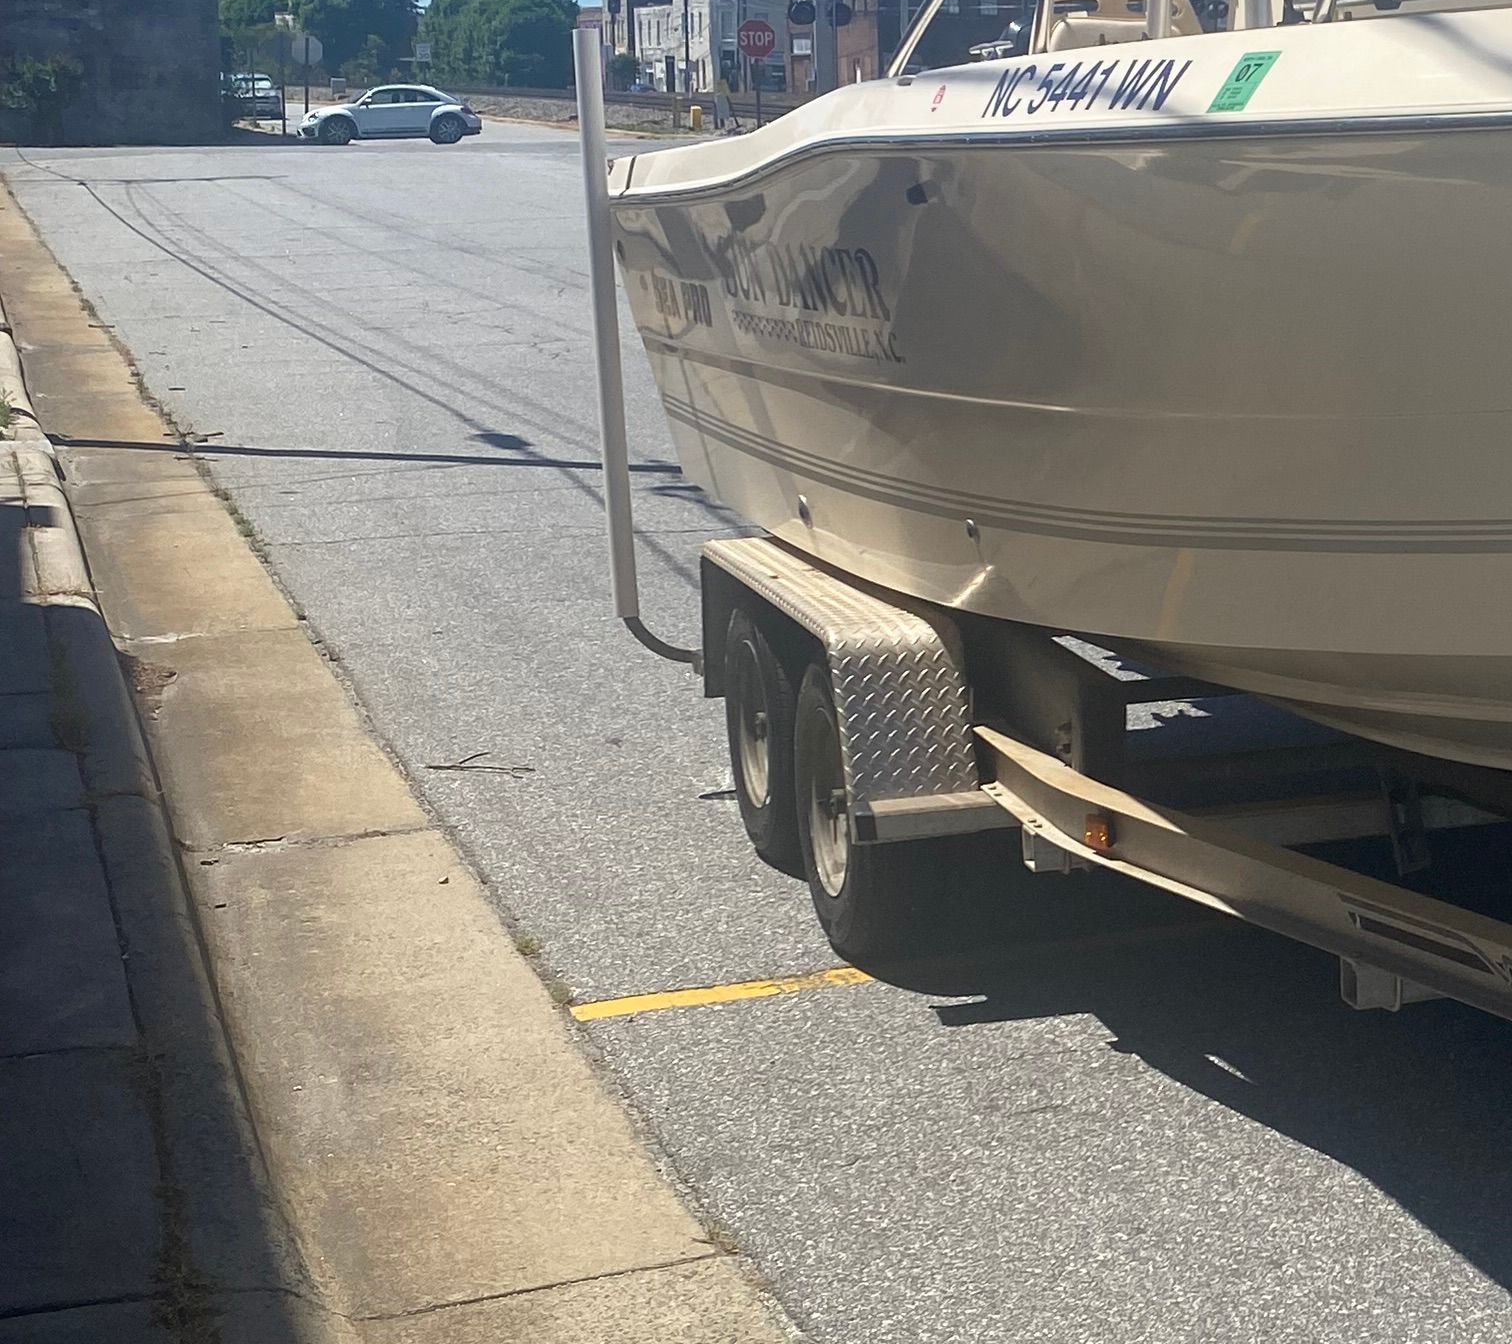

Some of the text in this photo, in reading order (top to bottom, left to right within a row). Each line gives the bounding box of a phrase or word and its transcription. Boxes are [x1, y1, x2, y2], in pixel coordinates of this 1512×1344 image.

[740, 32, 773, 46] STOP
[981, 64, 1035, 118] NC
[1027, 59, 1120, 114] 5441
[1108, 59, 1193, 112] WN
[1235, 63, 1264, 82] 07
[718, 234, 891, 322] SUN DANCER
